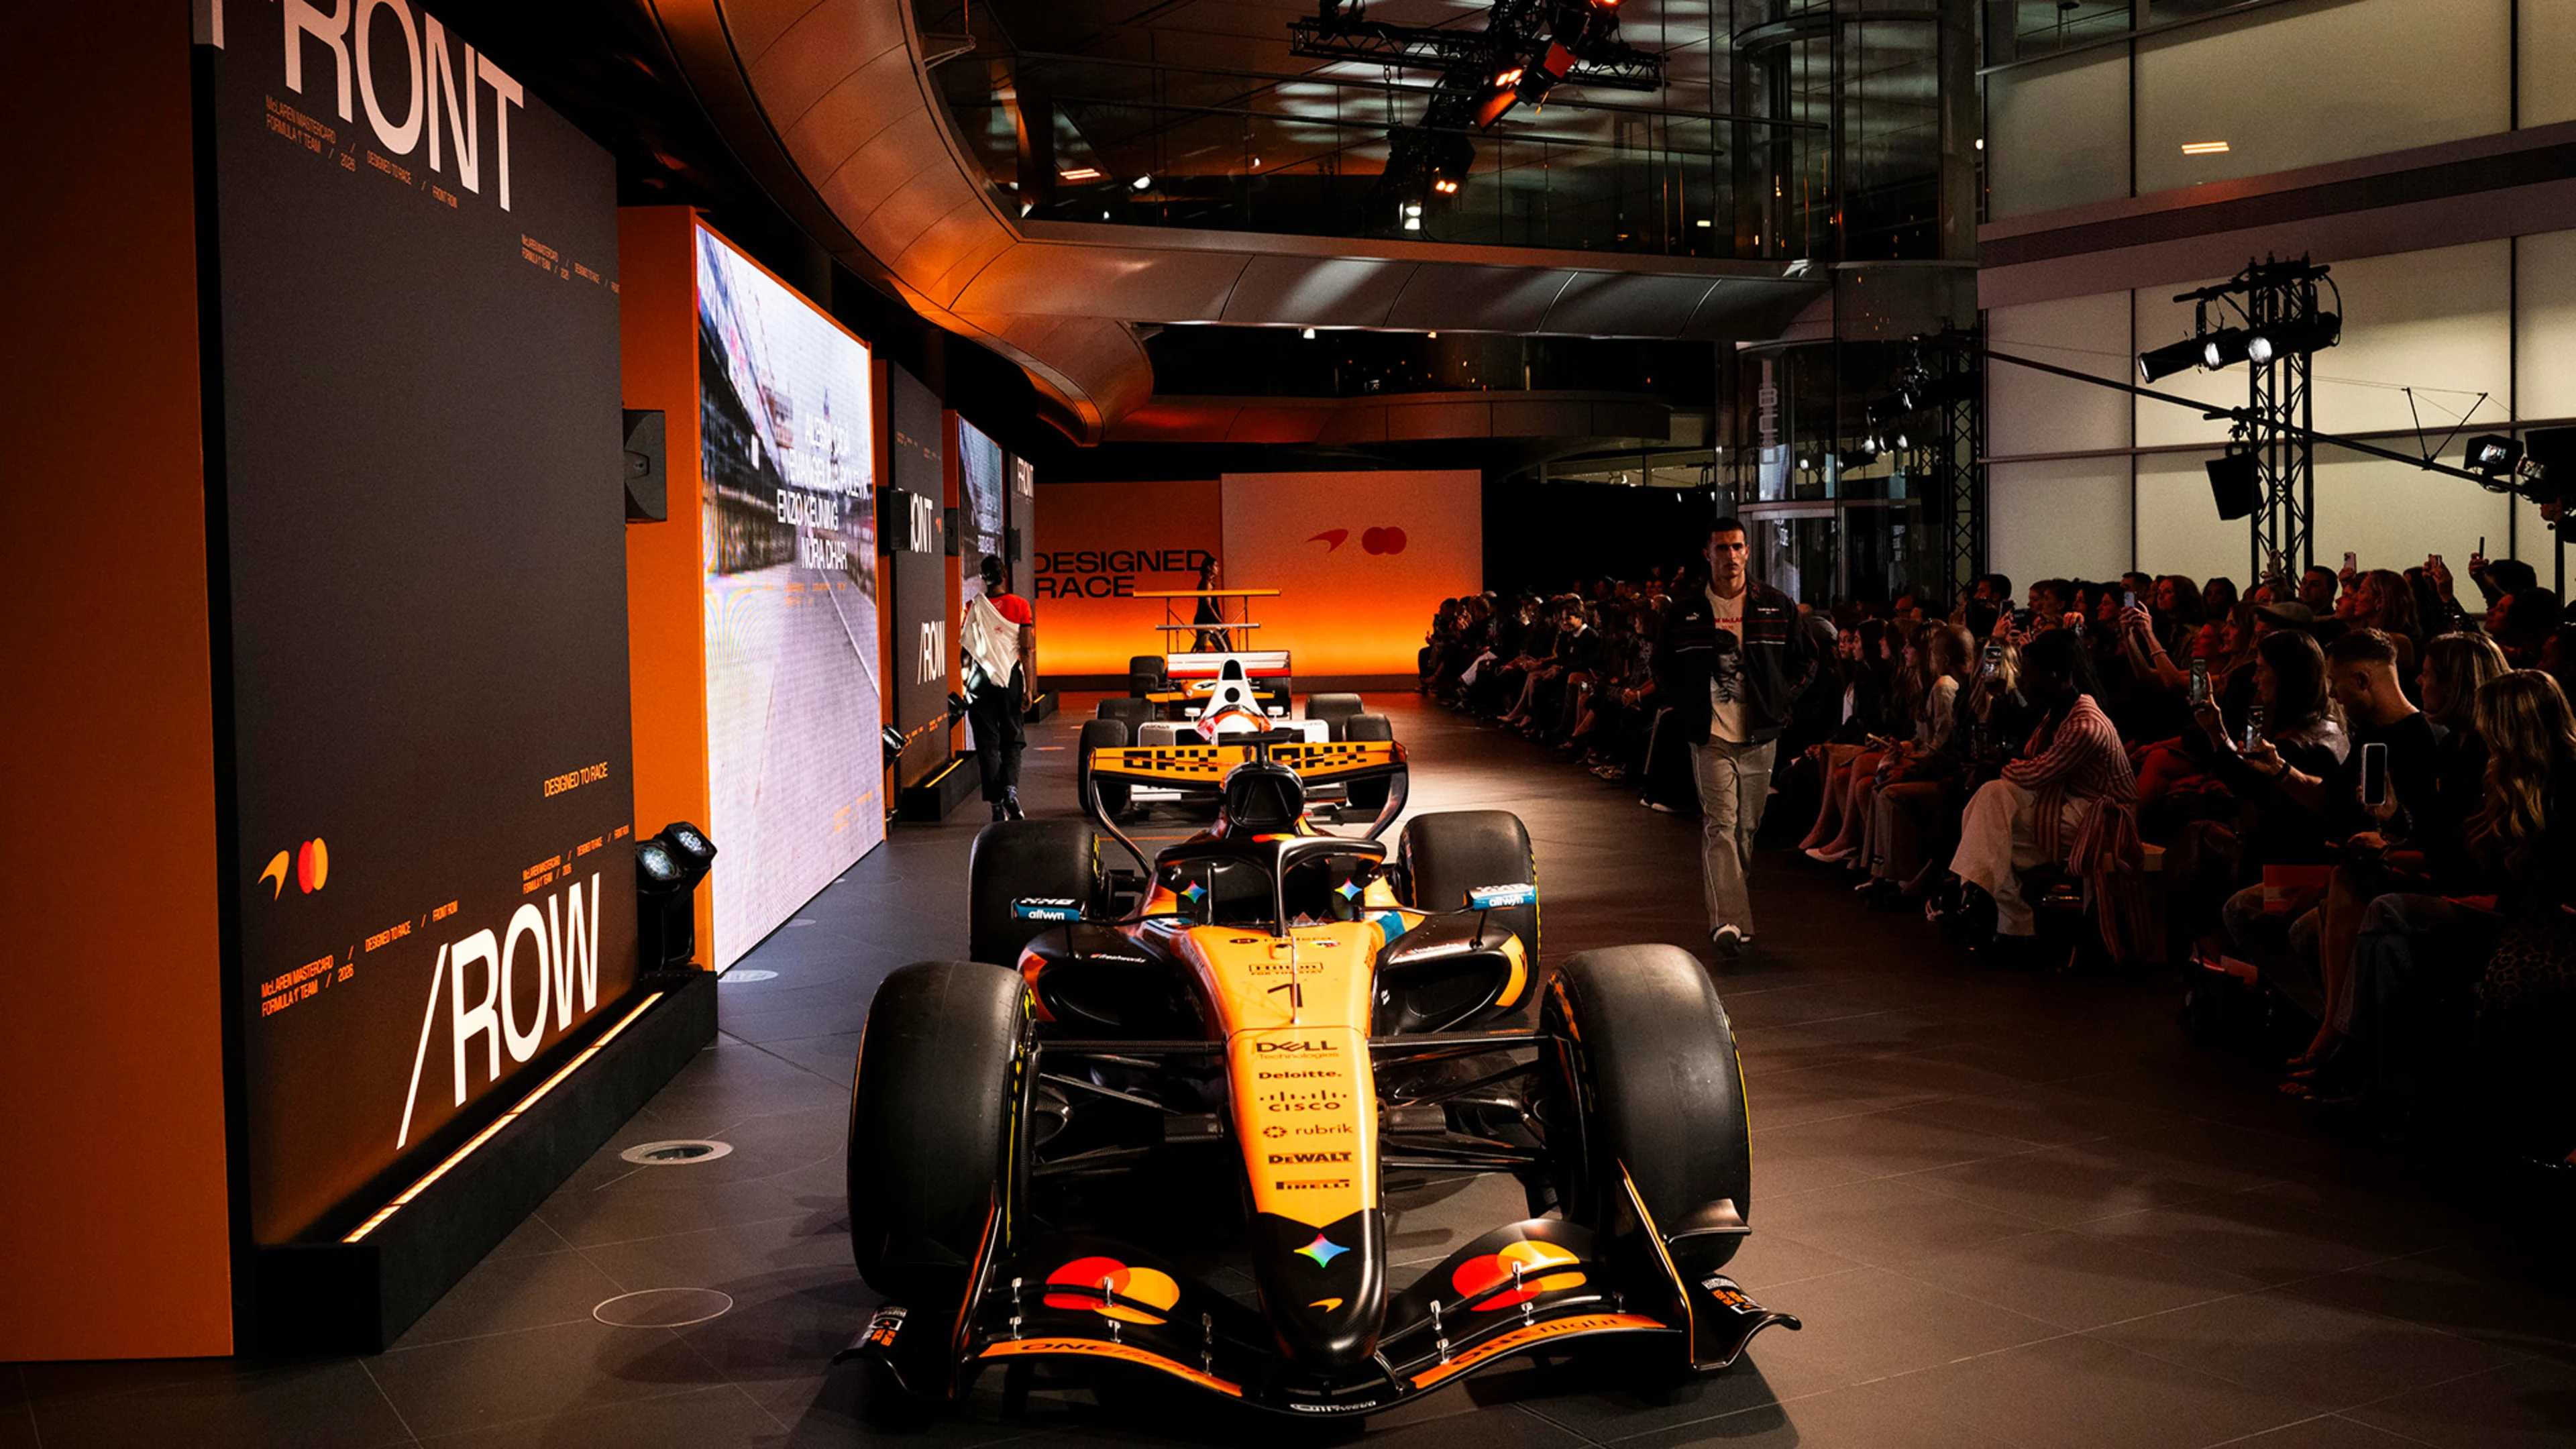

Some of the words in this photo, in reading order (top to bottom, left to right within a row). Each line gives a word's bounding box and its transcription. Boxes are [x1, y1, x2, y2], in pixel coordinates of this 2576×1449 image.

[211, 0, 523, 212] RONT
[777, 488, 803, 526] ENZO
[801, 537, 825, 570] NORA
[826, 539, 848, 570] DHAR
[1034, 550, 1212, 574] DESIGNED
[1034, 575, 1135, 598] RACE
[1124, 749, 1218, 771] OKX
[1272, 745, 1366, 769] OKX
[544, 771, 580, 798] DESIGNED
[580, 767, 590, 785] TO
[590, 761, 608, 782] RACE
[1028, 909, 1065, 921] allwyn
[261, 971, 292, 998] McLAREN
[292, 955, 334, 986] MASTERCARD
[365, 930, 390, 953] DESIGNED
[261, 989, 294, 1017] FORMULA
[300, 979, 319, 1000] TEAM
[396, 872, 600, 1151] /ROW
[1256, 1040, 1338, 1053] DELL
[1258, 1070, 1342, 1079] Deloitte.
[1268, 1102, 1340, 1112] CISCO
[1295, 1123, 1353, 1135] rubrik
